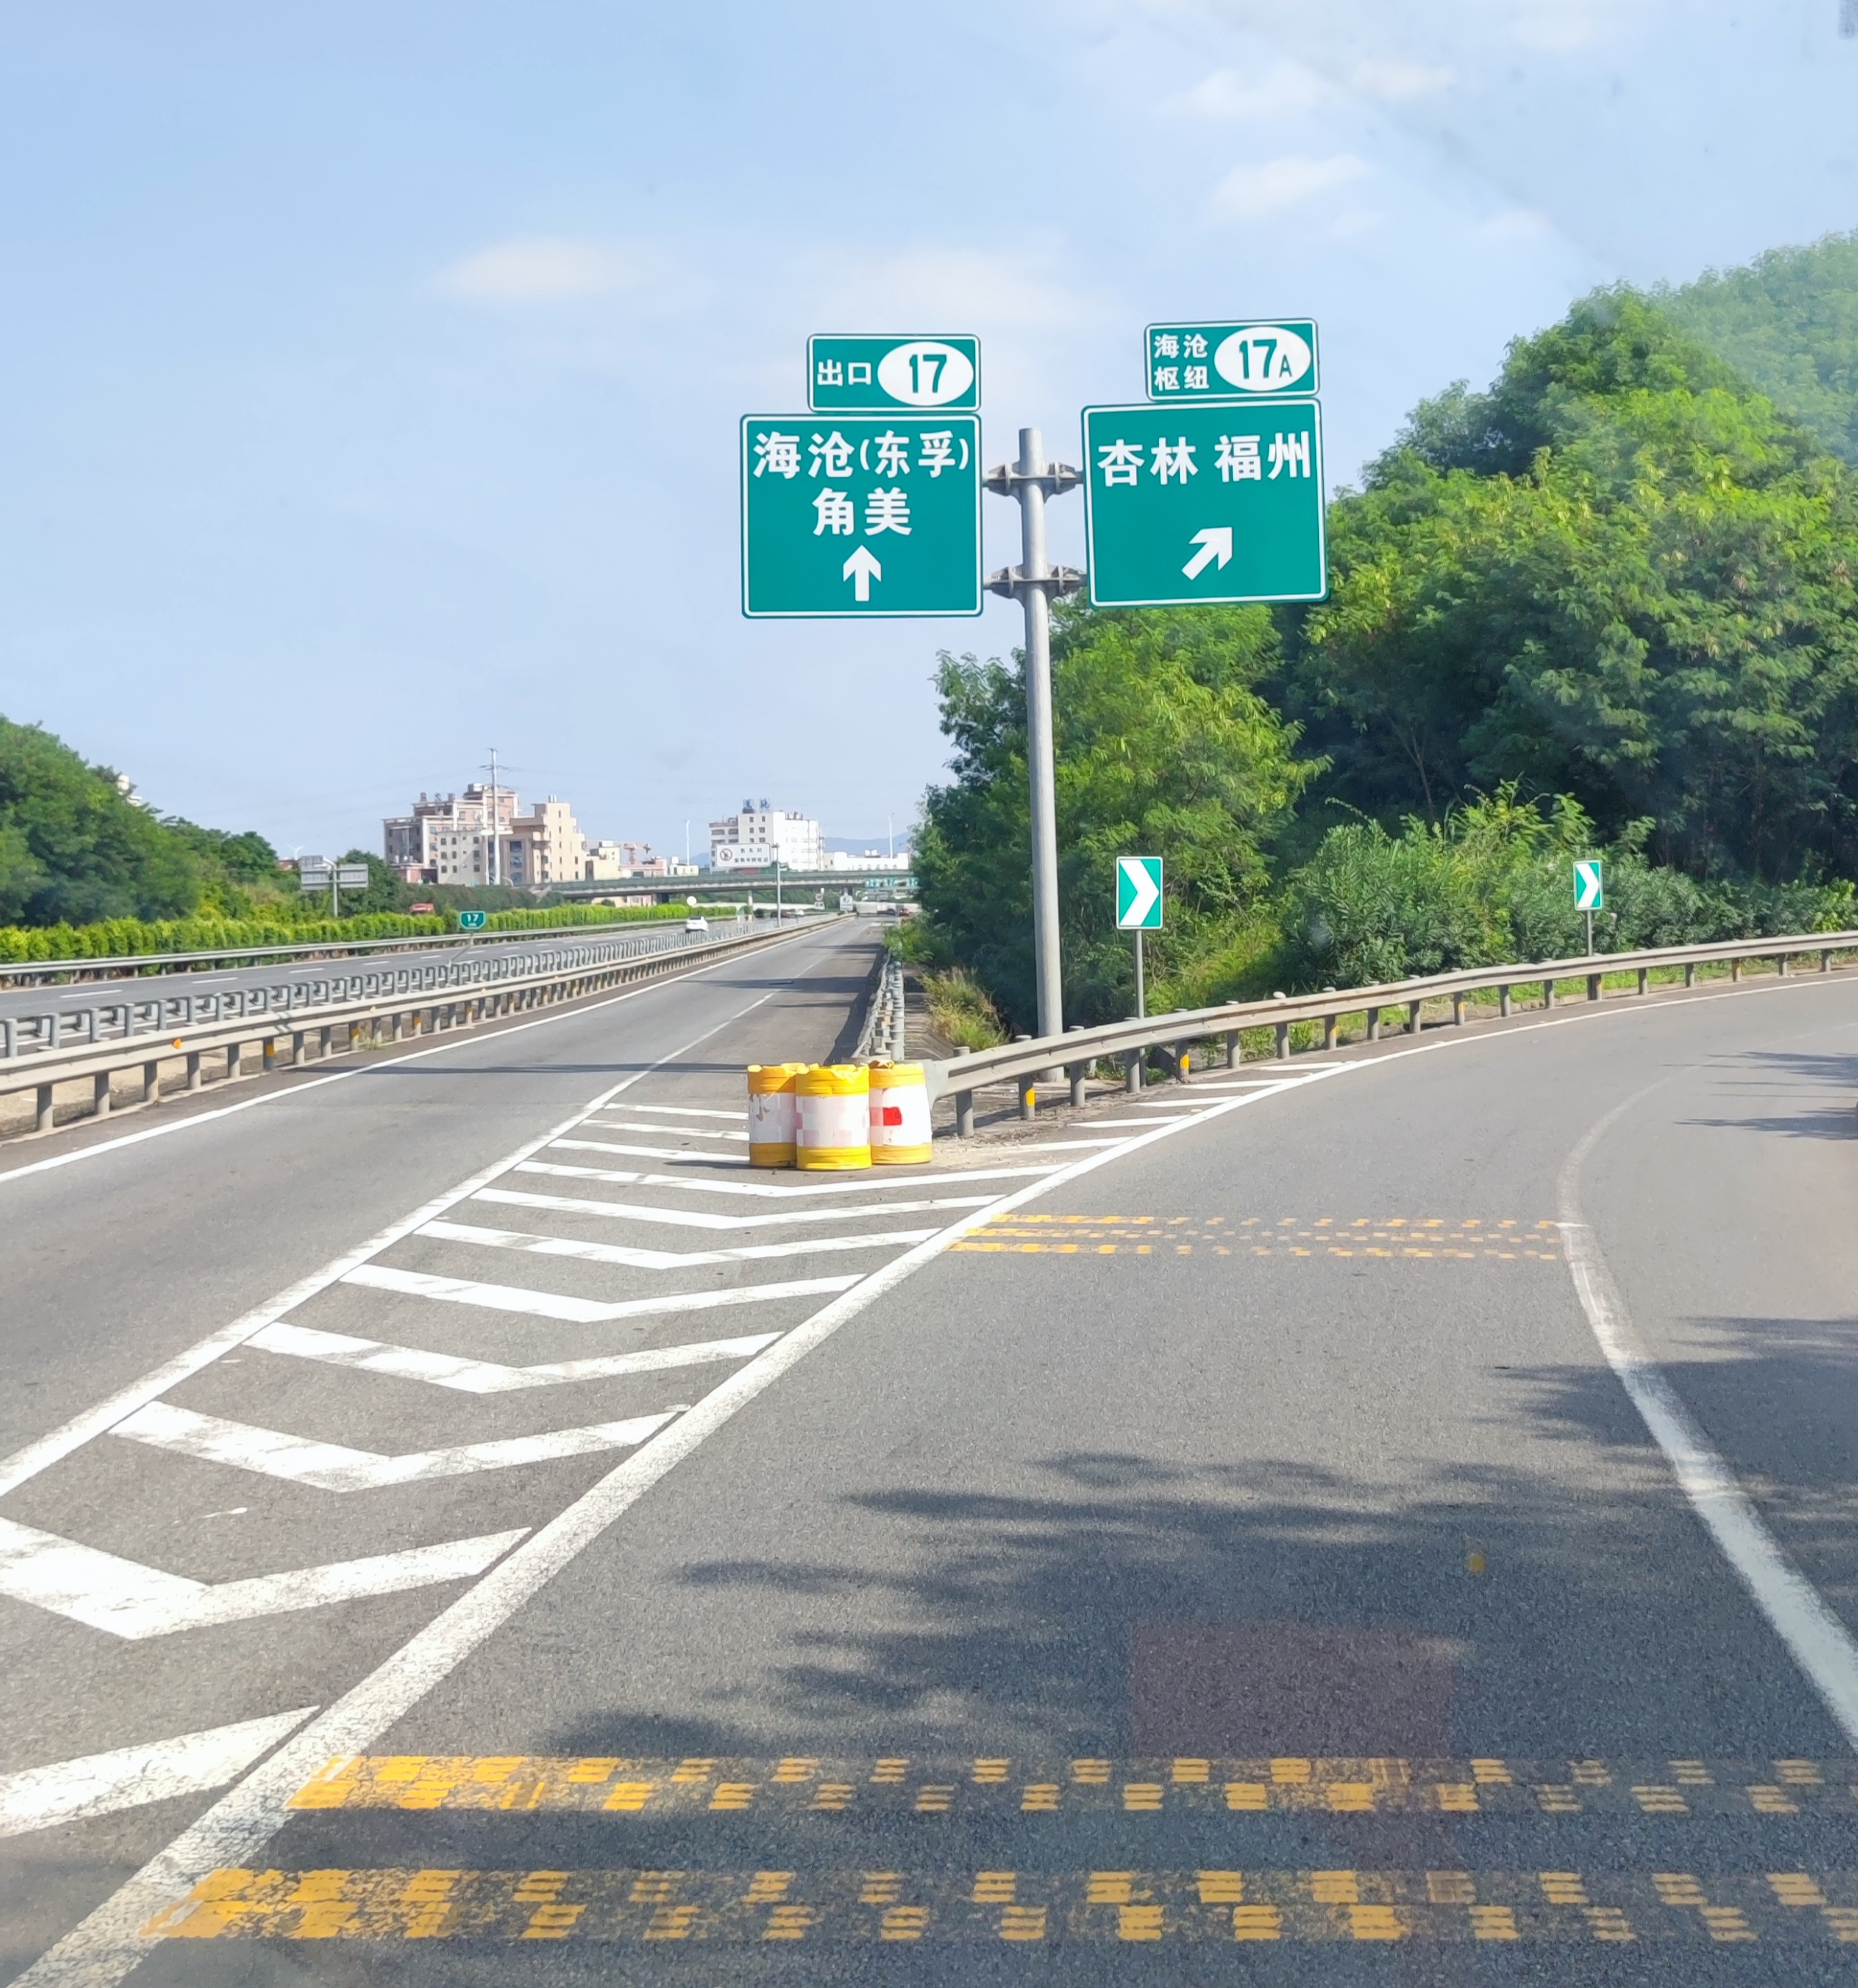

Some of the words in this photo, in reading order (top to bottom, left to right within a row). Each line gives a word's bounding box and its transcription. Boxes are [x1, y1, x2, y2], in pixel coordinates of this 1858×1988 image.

[1154, 333, 1209, 359] 海沧
[1239, 338, 1292, 379] 17A
[816, 359, 872, 386] 出口
[909, 353, 948, 393] 17
[1154, 365, 1209, 391] 枢纽
[1097, 437, 1199, 487] 杏林
[1214, 431, 1311, 482] 福州
[811, 487, 913, 536] 角美
